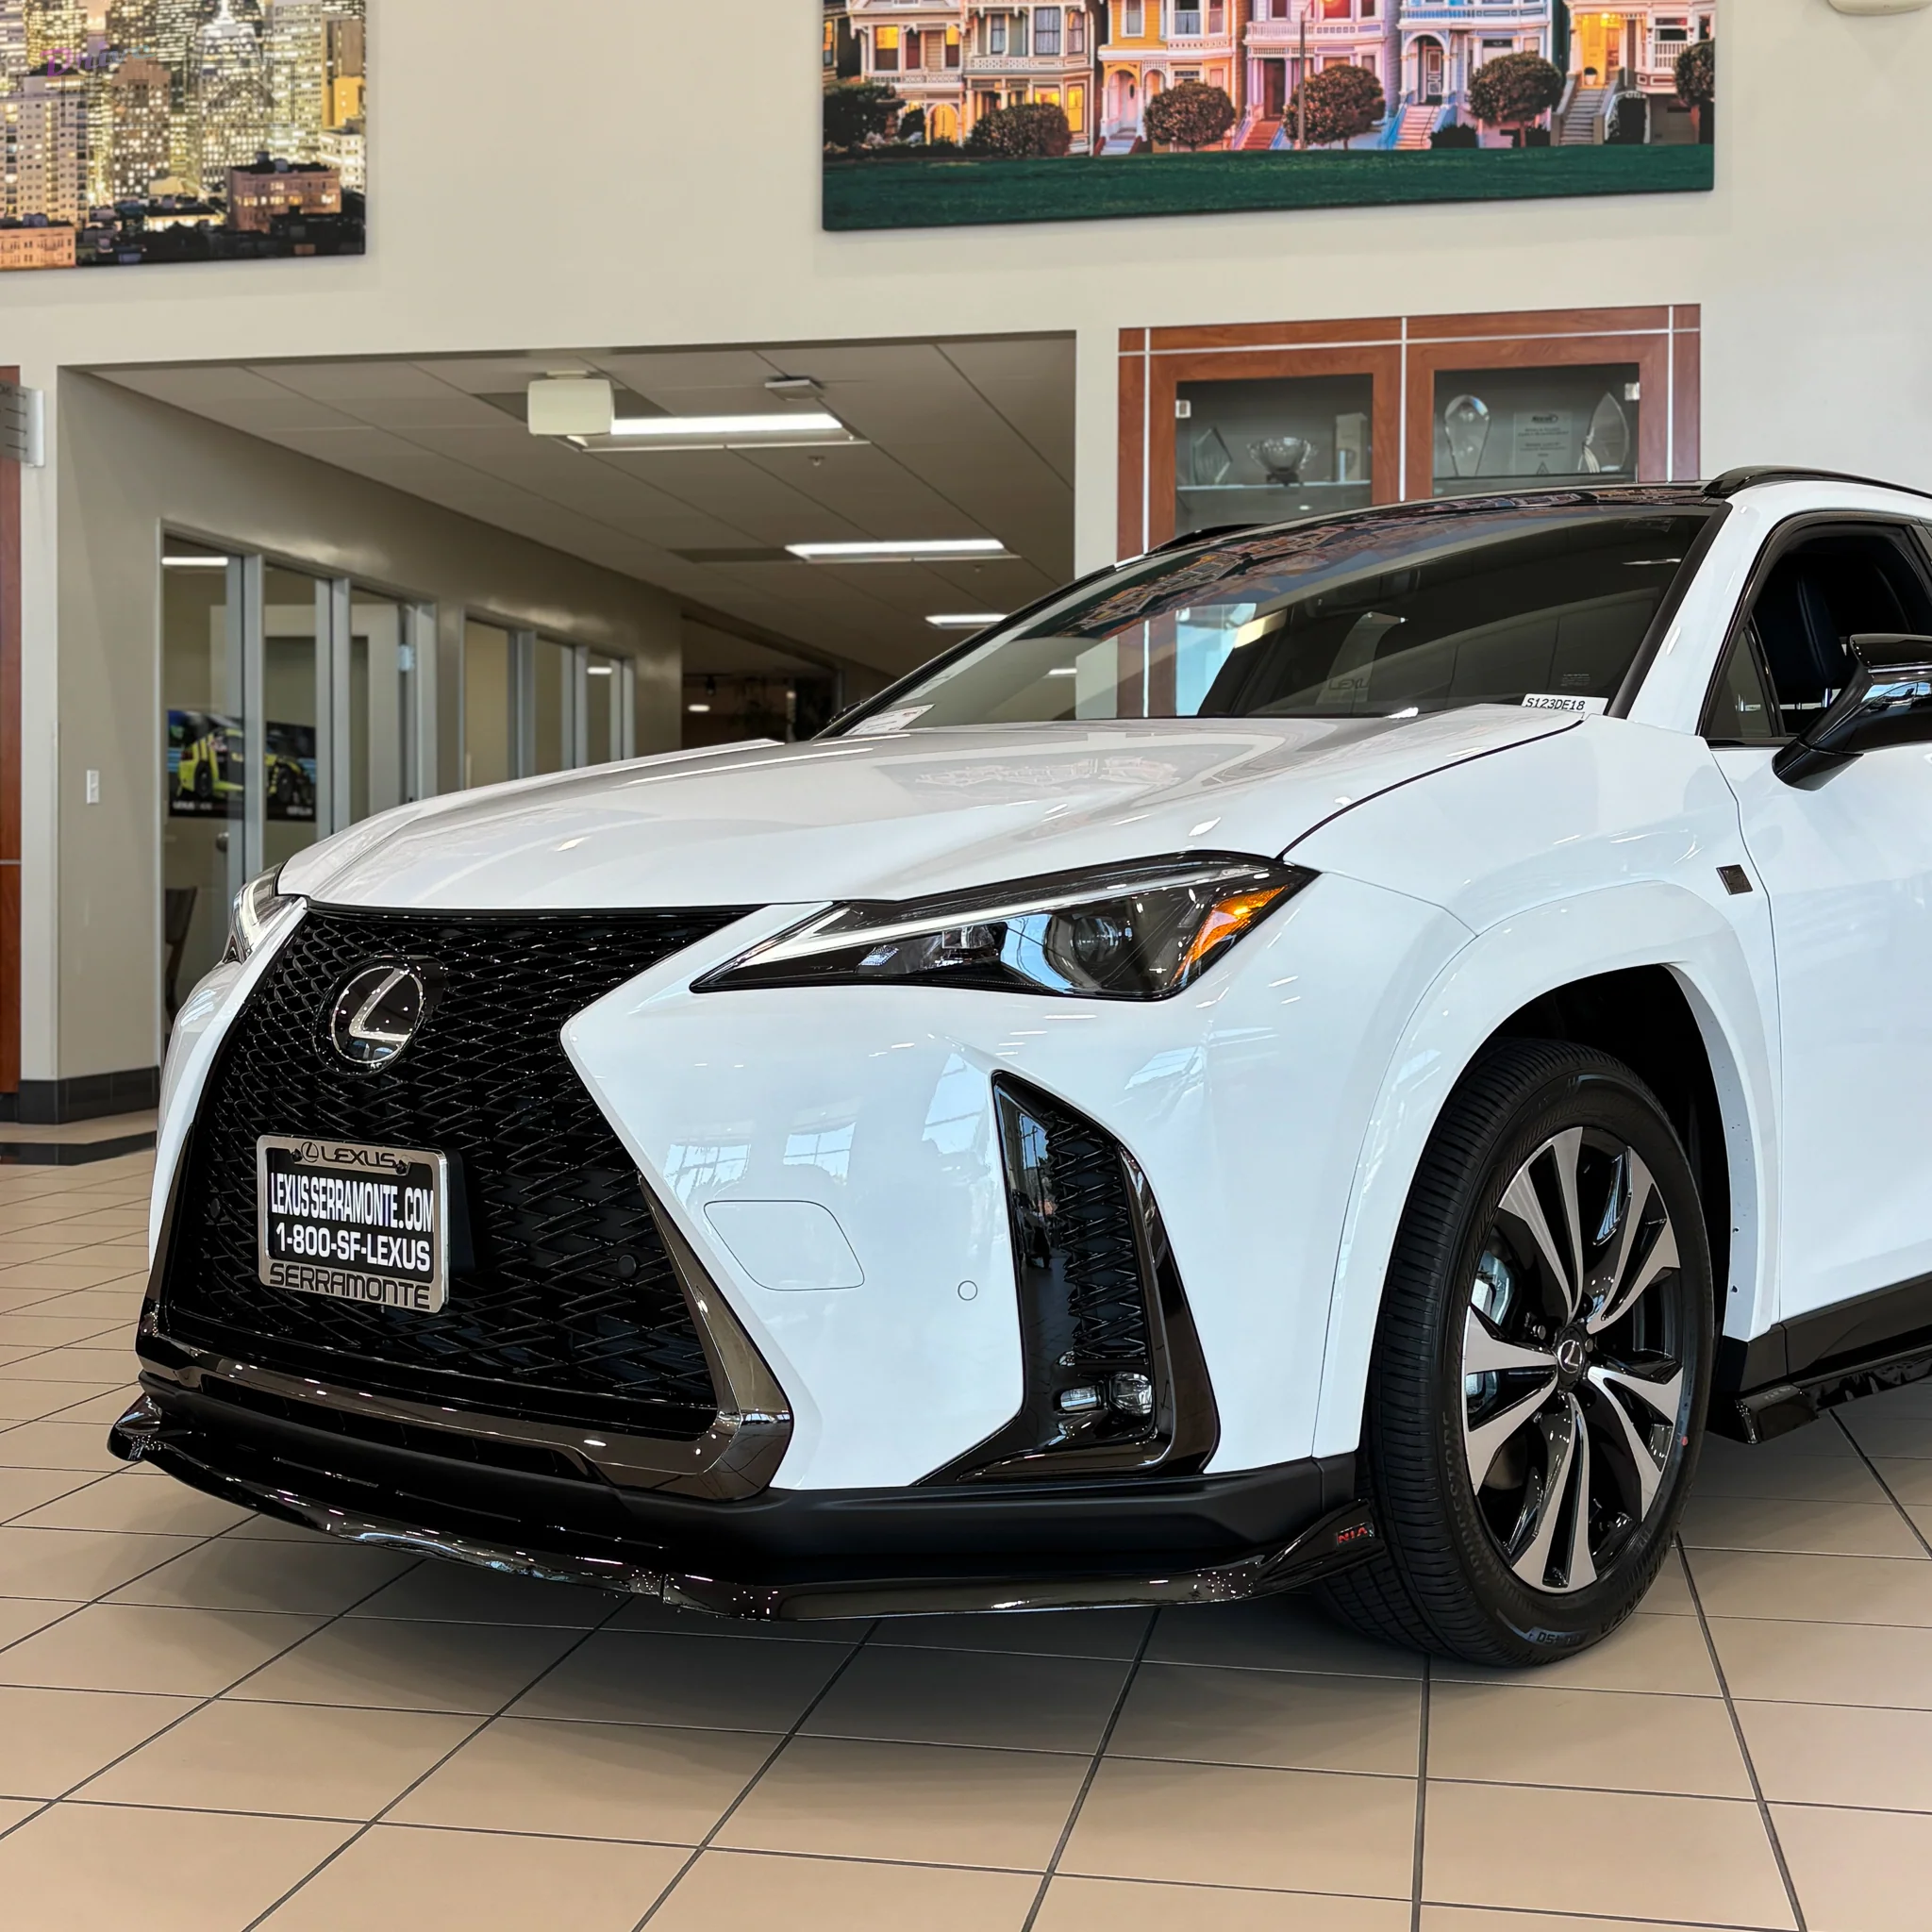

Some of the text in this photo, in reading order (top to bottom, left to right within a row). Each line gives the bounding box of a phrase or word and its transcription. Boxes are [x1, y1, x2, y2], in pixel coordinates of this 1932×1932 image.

[1525, 697, 1586, 711] S123DE18
[321, 1145, 397, 1168] LEXUS
[275, 1222, 431, 1272] 1-800-SF-LEXUS
[269, 1262, 430, 1310] SERRAMONTE
